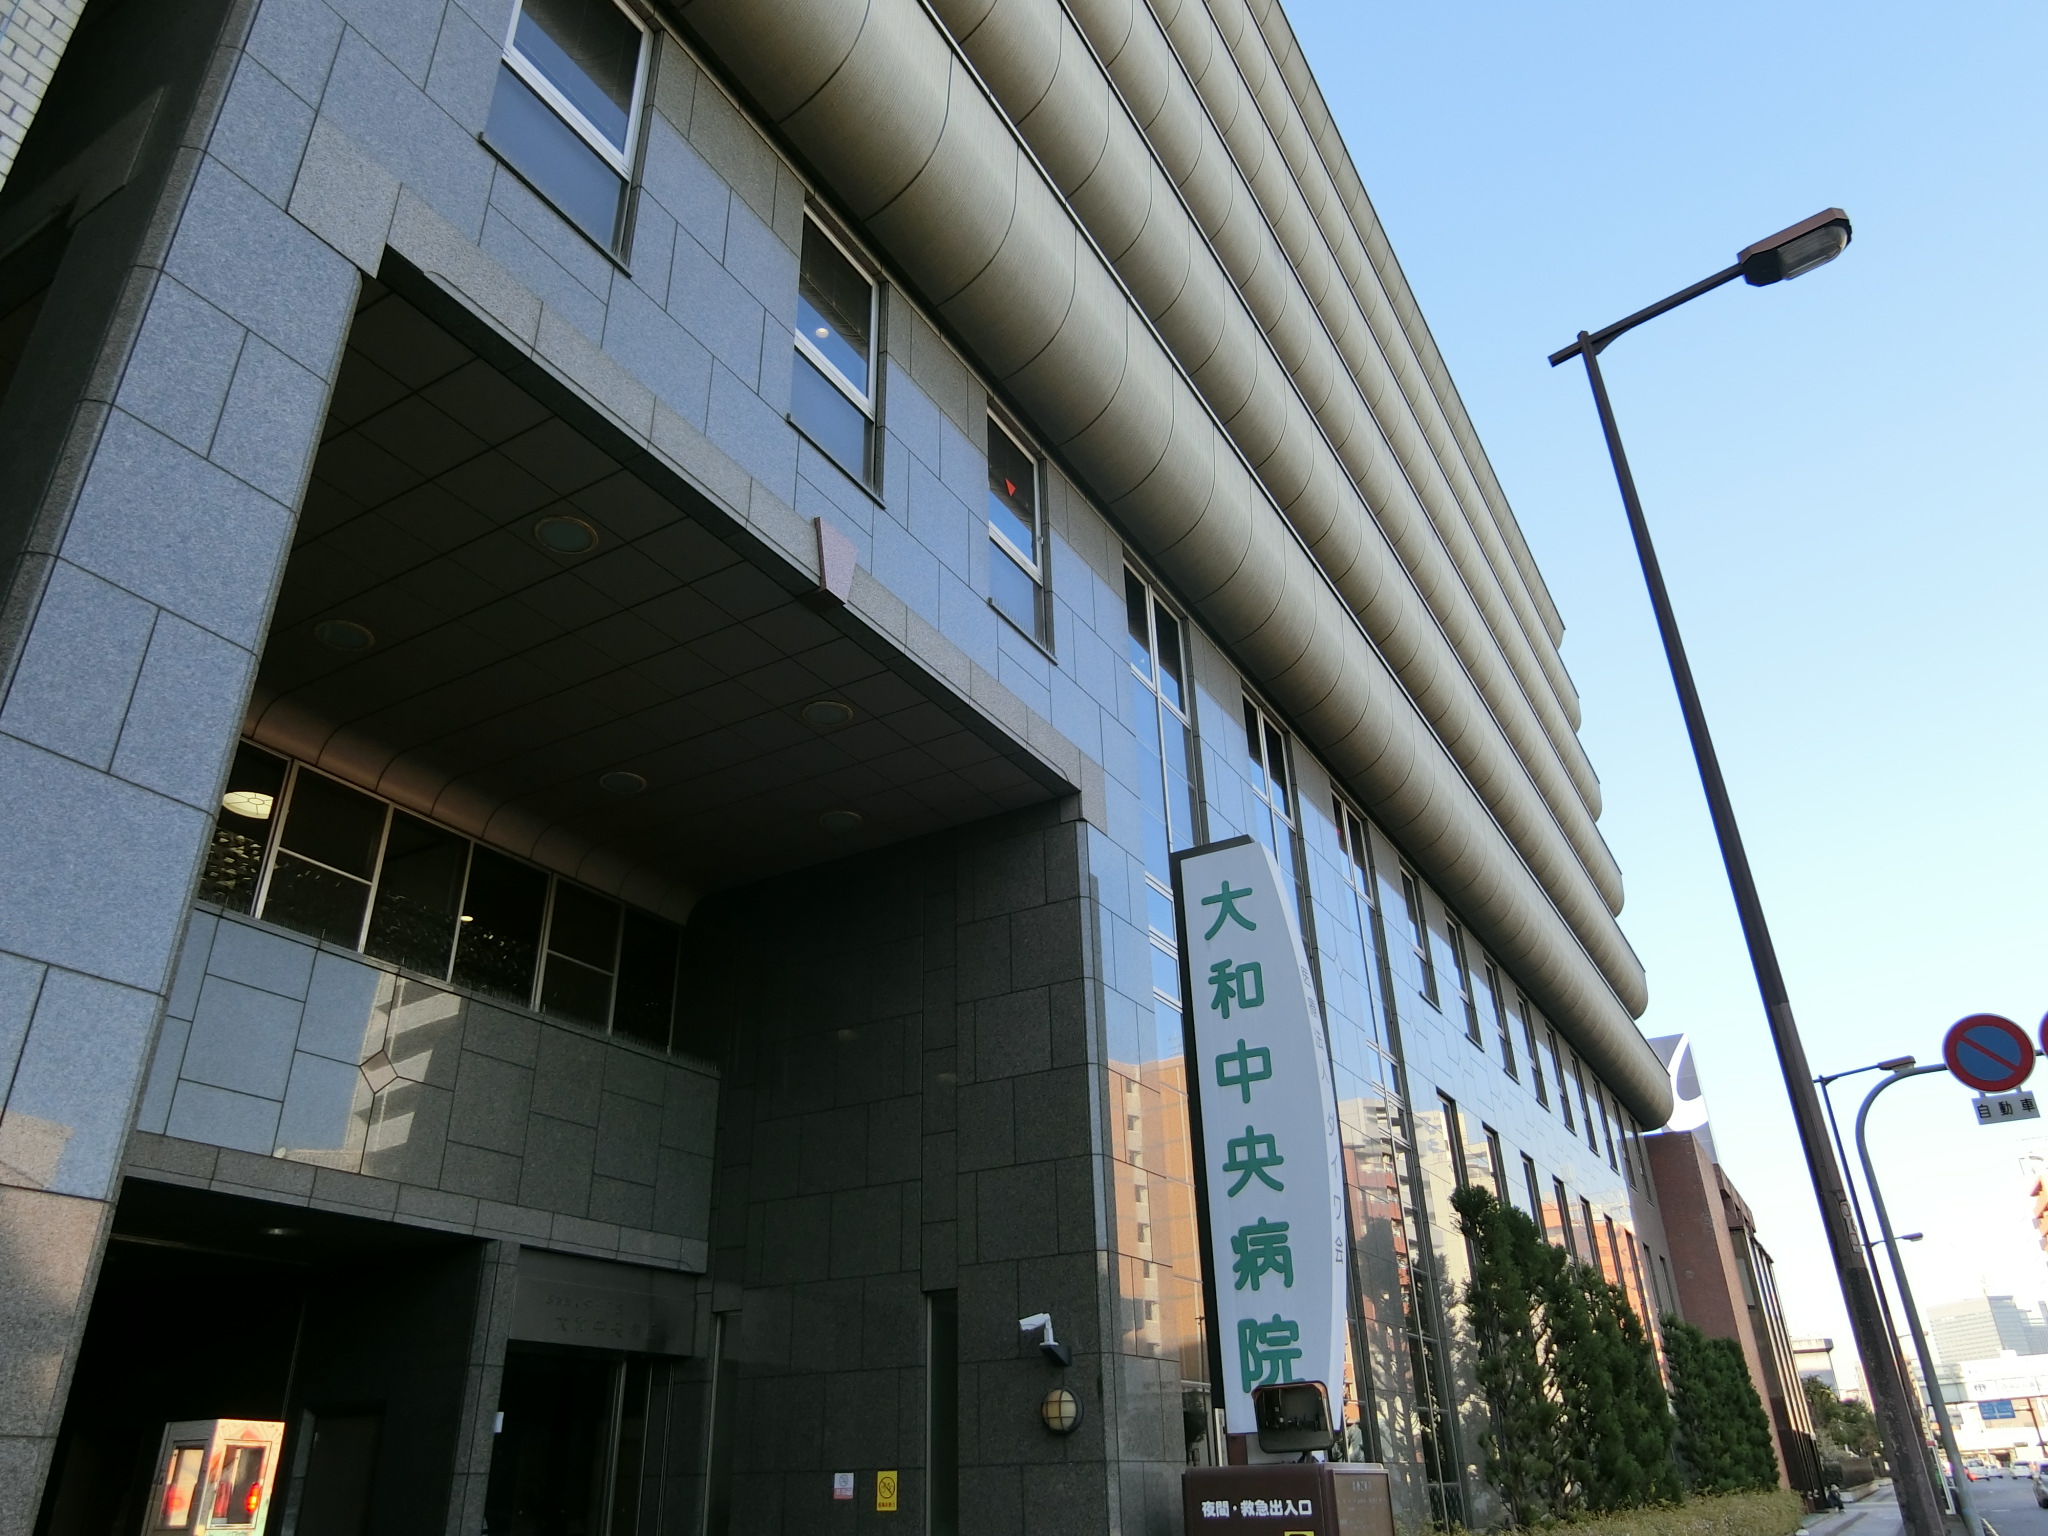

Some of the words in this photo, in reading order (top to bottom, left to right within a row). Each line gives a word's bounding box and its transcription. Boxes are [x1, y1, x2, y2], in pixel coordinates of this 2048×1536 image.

[1977, 1098, 2036, 1118] 自動車
[1201, 880, 1305, 1393] 大和中央病院
[1201, 1500, 1312, 1517] 夜間・救急出入口
